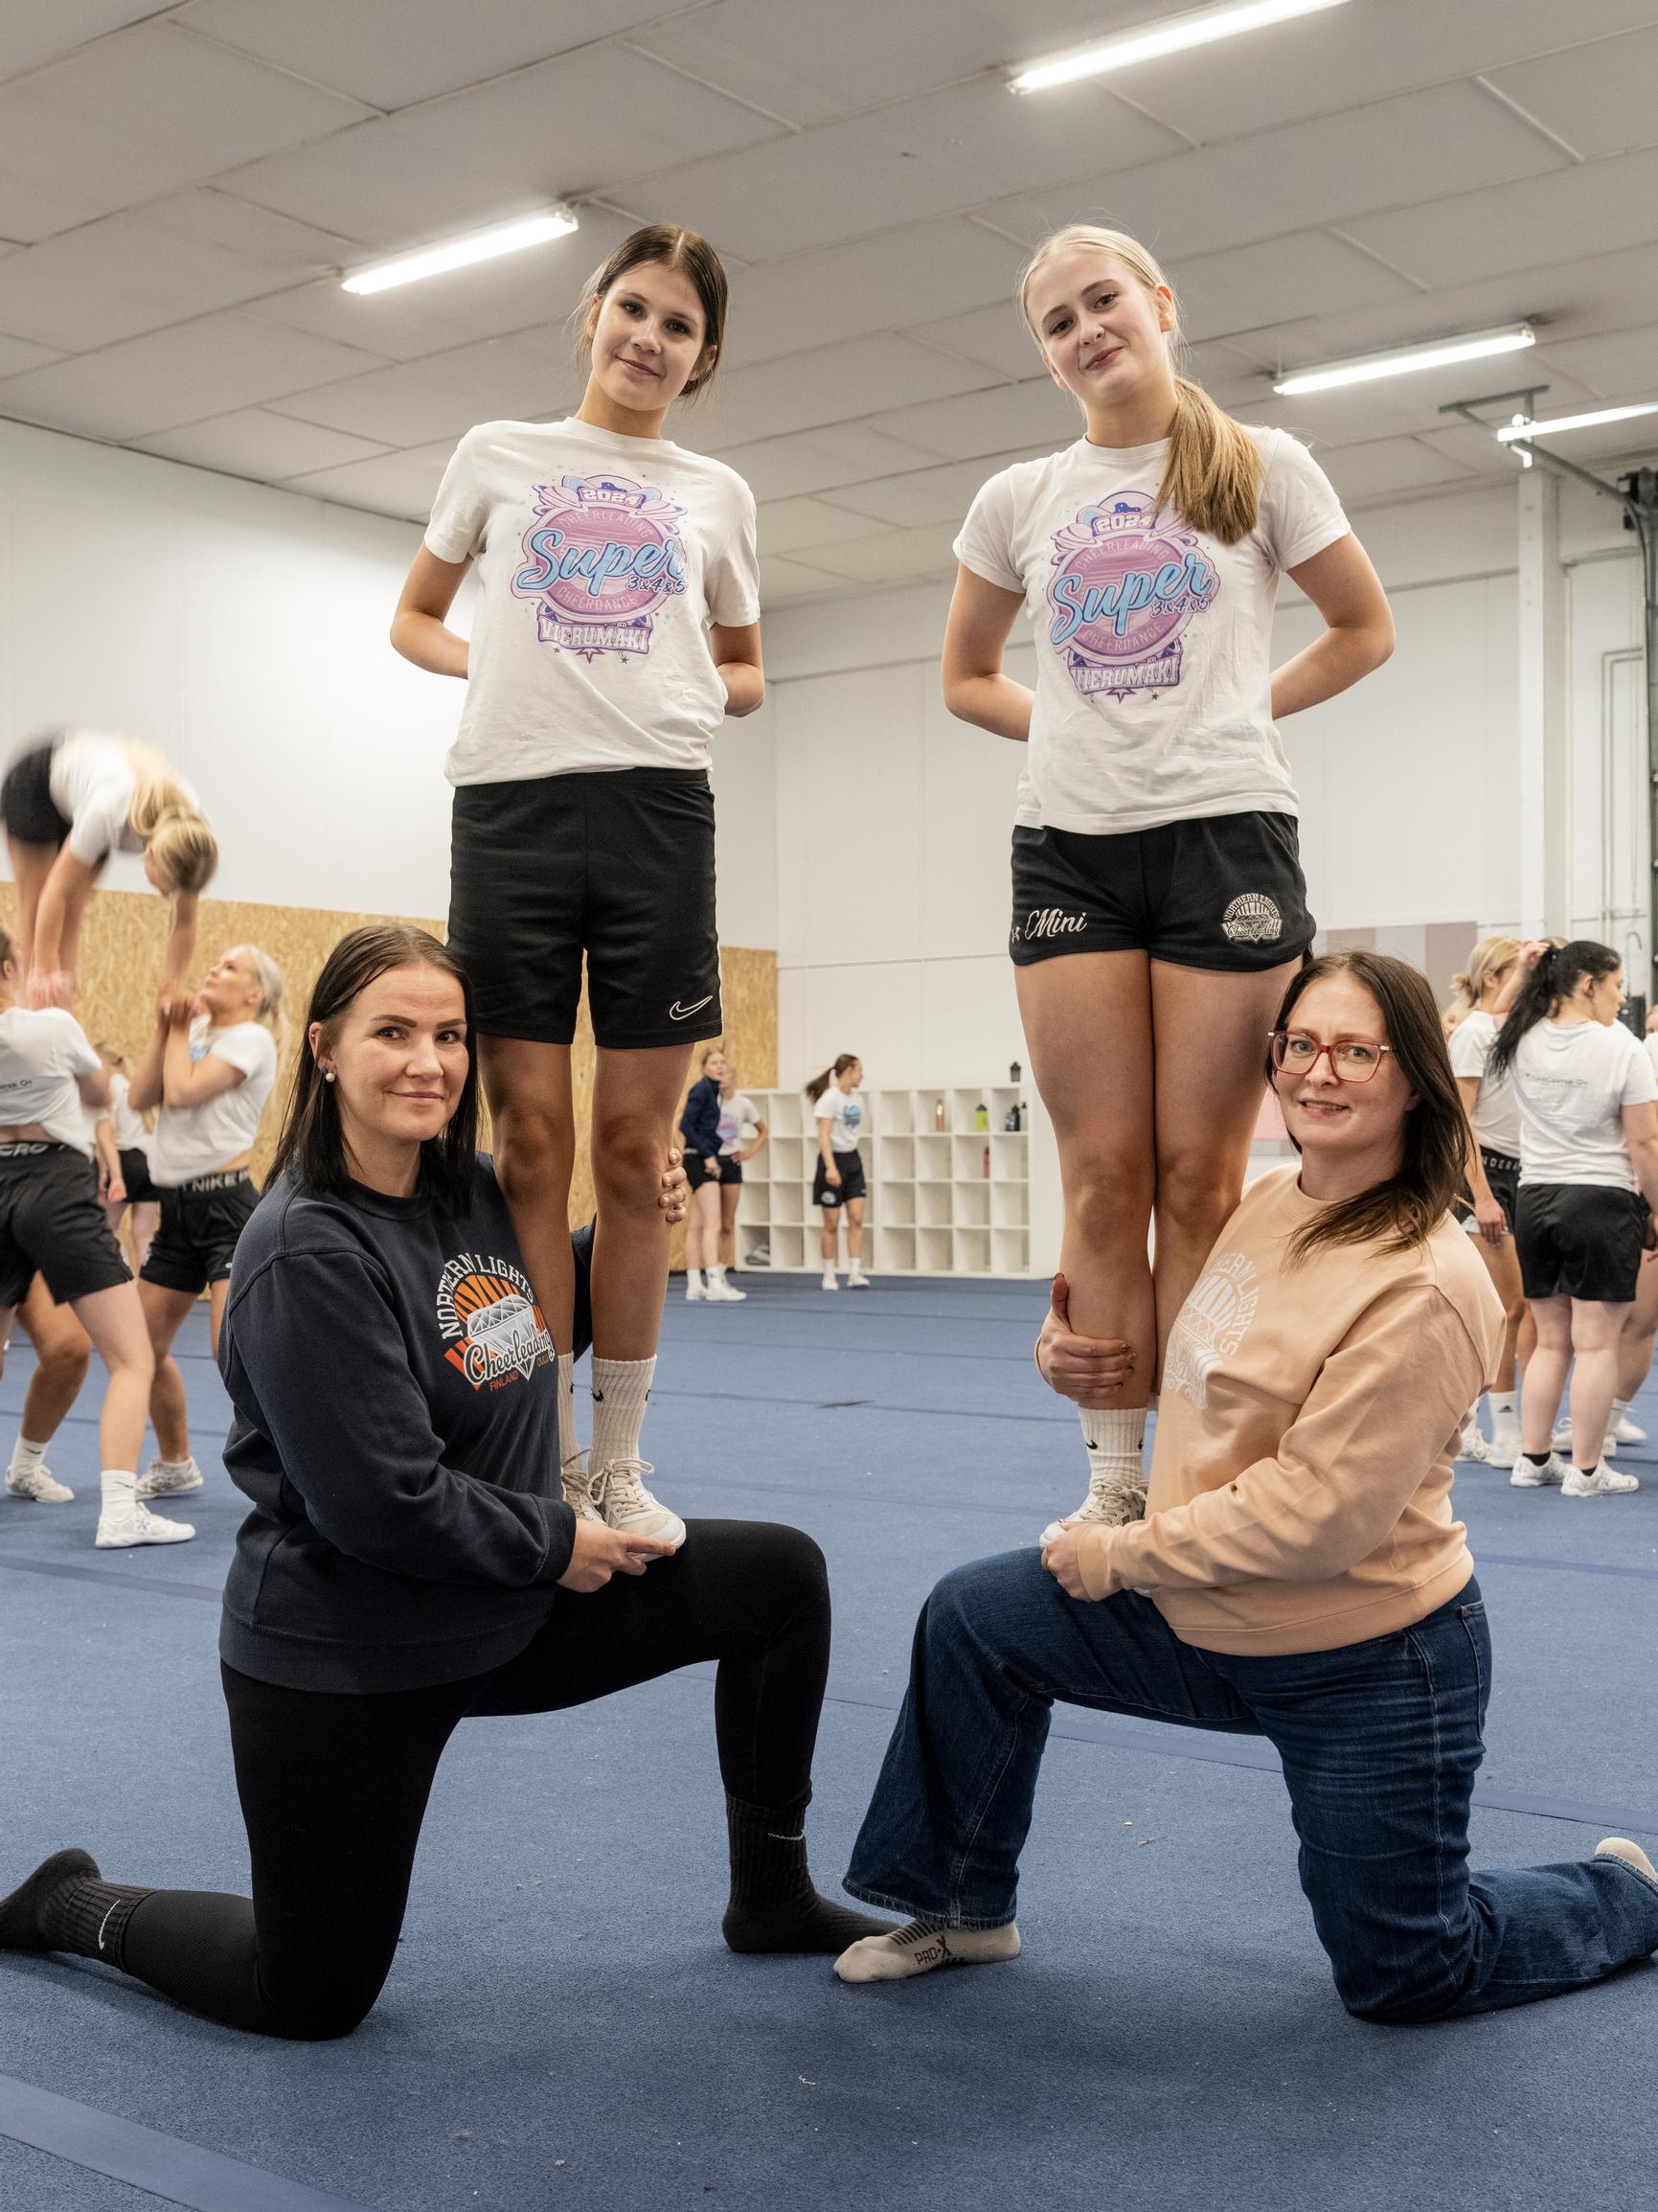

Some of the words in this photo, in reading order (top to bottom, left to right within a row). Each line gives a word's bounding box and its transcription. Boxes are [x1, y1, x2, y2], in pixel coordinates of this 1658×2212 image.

[582, 490, 642, 507] 2024
[558, 510, 653, 538] CHEERLEADING
[1095, 513, 1152, 531] 2024
[517, 530, 685, 596] Super
[556, 586, 639, 611] CHEERDANCE
[1051, 553, 1213, 645] Super
[1223, 893, 1259, 921] NORTHERN
[1260, 894, 1281, 920] LIGHTS
[1024, 908, 1088, 940] Mini
[191, 1171, 237, 1192] NIKE
[474, 1253, 534, 1304] LIGHTS
[463, 1321, 556, 1385] Cheerleading
[489, 1370, 519, 1393] FINLAND
[914, 1934, 953, 1966] PRO-X
